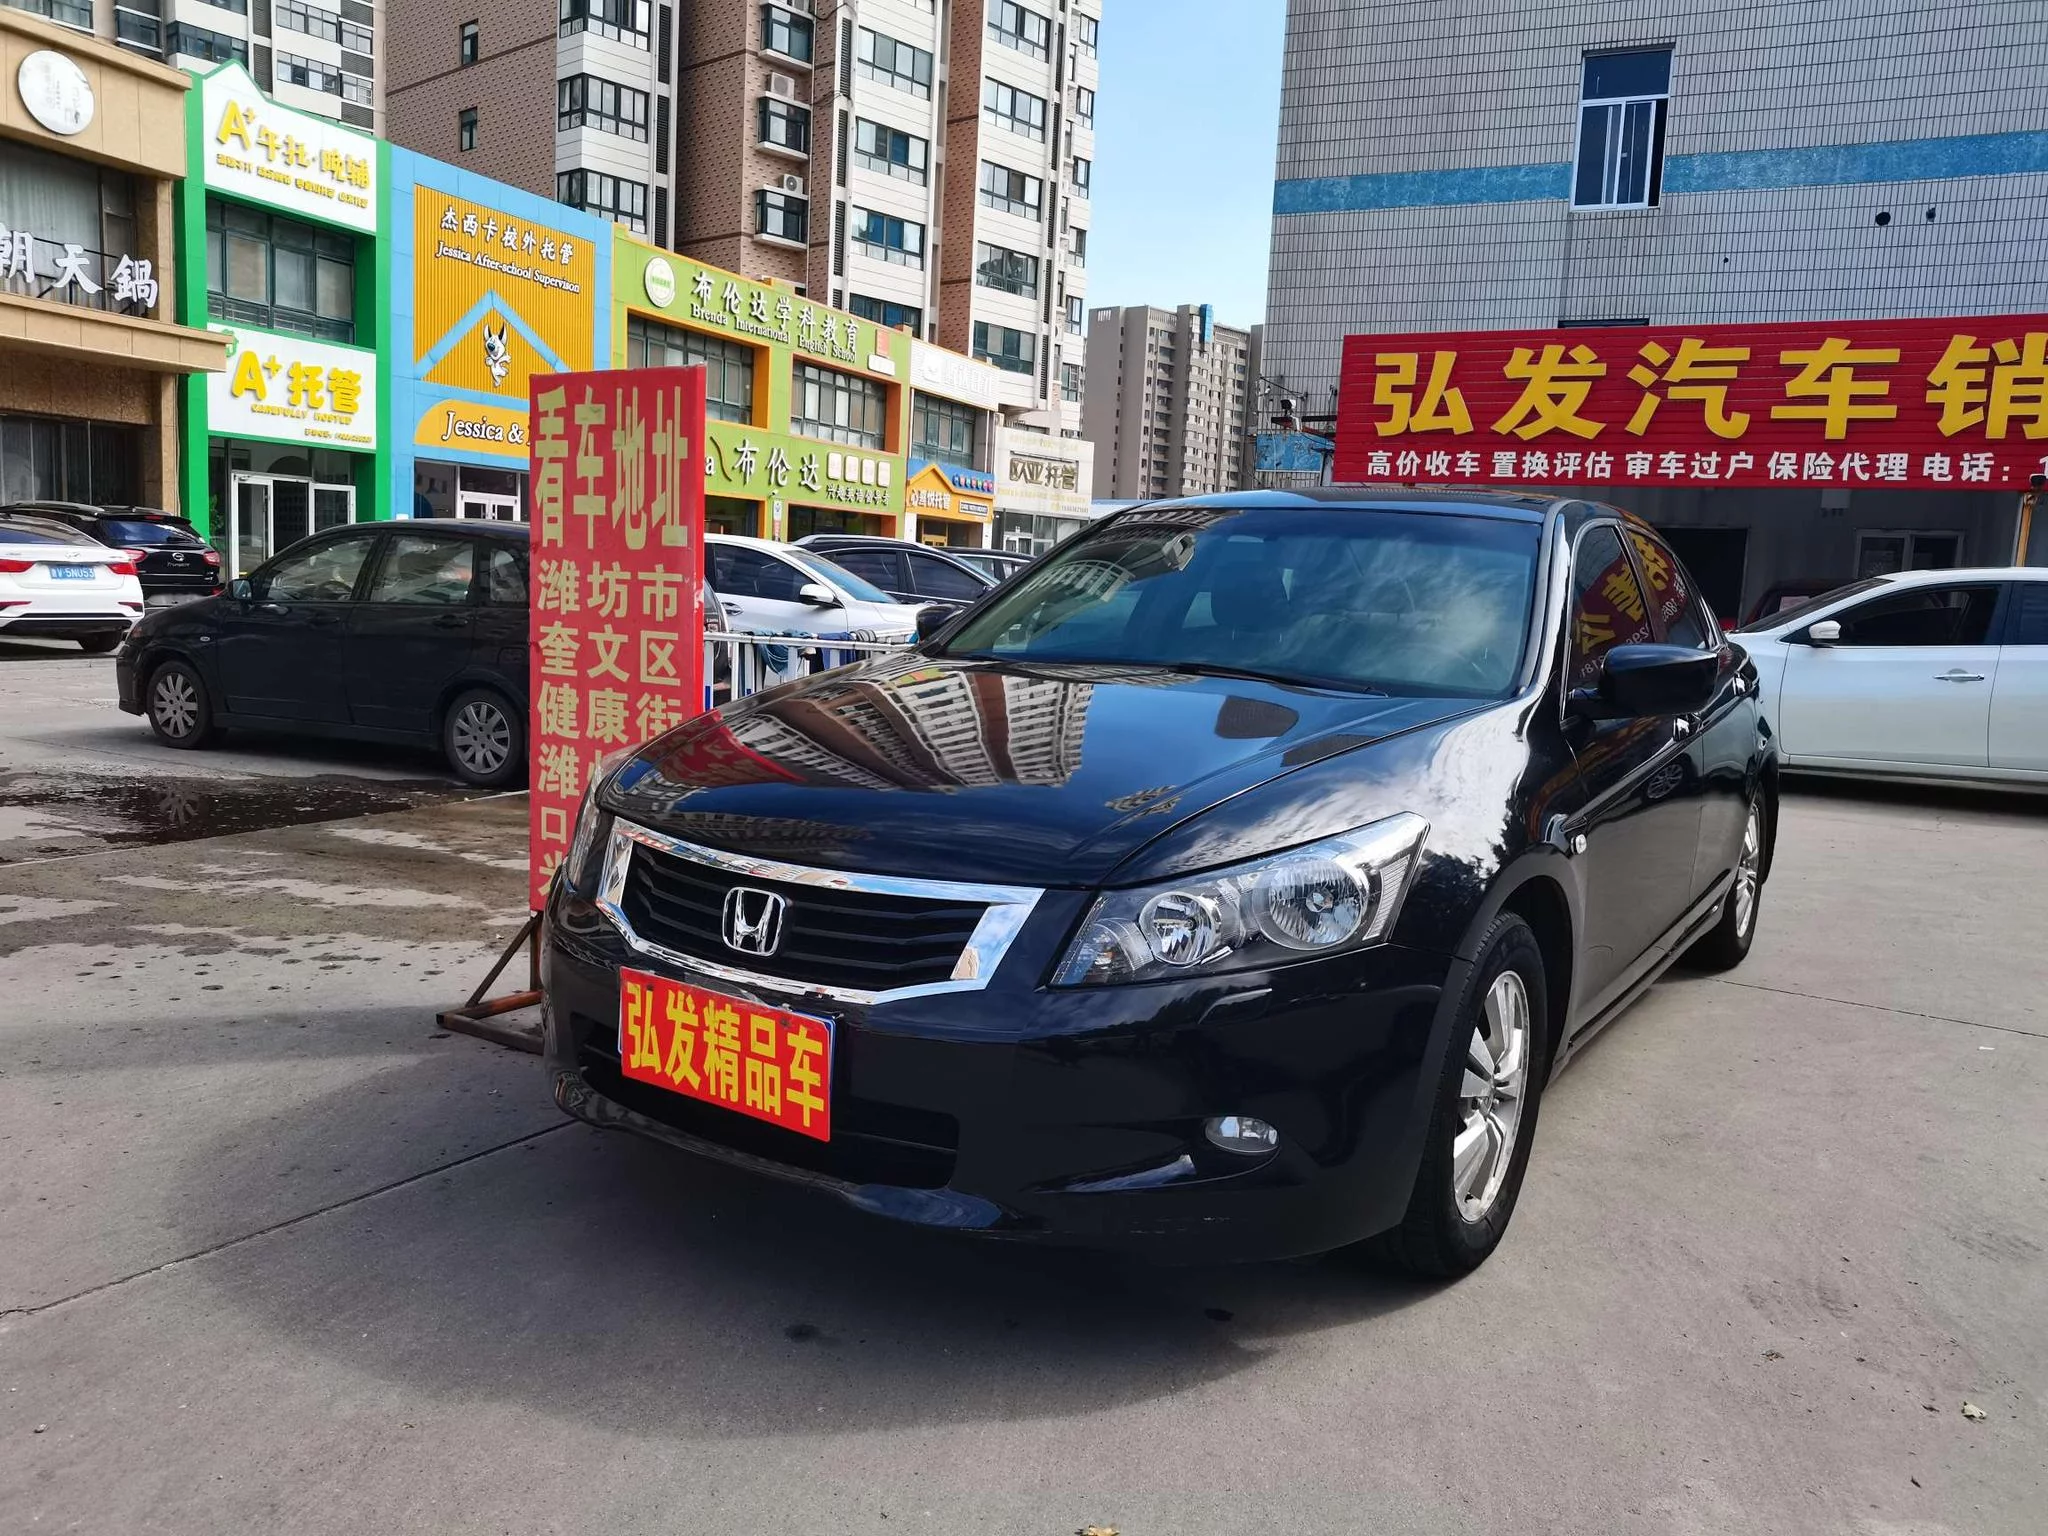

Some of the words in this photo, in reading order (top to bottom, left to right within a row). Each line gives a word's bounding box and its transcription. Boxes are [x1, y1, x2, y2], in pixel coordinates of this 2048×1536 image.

[436, 241, 472, 262] Jessica
[473, 252, 532, 279] After-school
[441, 205, 574, 264] 杰西卡校外托管
[691, 301, 729, 326] Brenda
[734, 317, 791, 345] International
[799, 333, 828, 357] English
[692, 270, 860, 353] 布伦达学科教育
[441, 410, 504, 441] Jessica
[535, 384, 689, 550] 看车地址
[734, 438, 822, 492] 布伦达
[1367, 449, 1481, 478] 高价收车
[1490, 449, 1614, 480] 置换评估
[1625, 451, 1755, 481] 审车过户
[1767, 451, 1909, 482] 保险代理
[537, 558, 683, 622] 潍坊市
[538, 620, 682, 687] 奎文区
[536, 680, 683, 742] 健康街
[626, 981, 825, 1128] 弘发精品车
